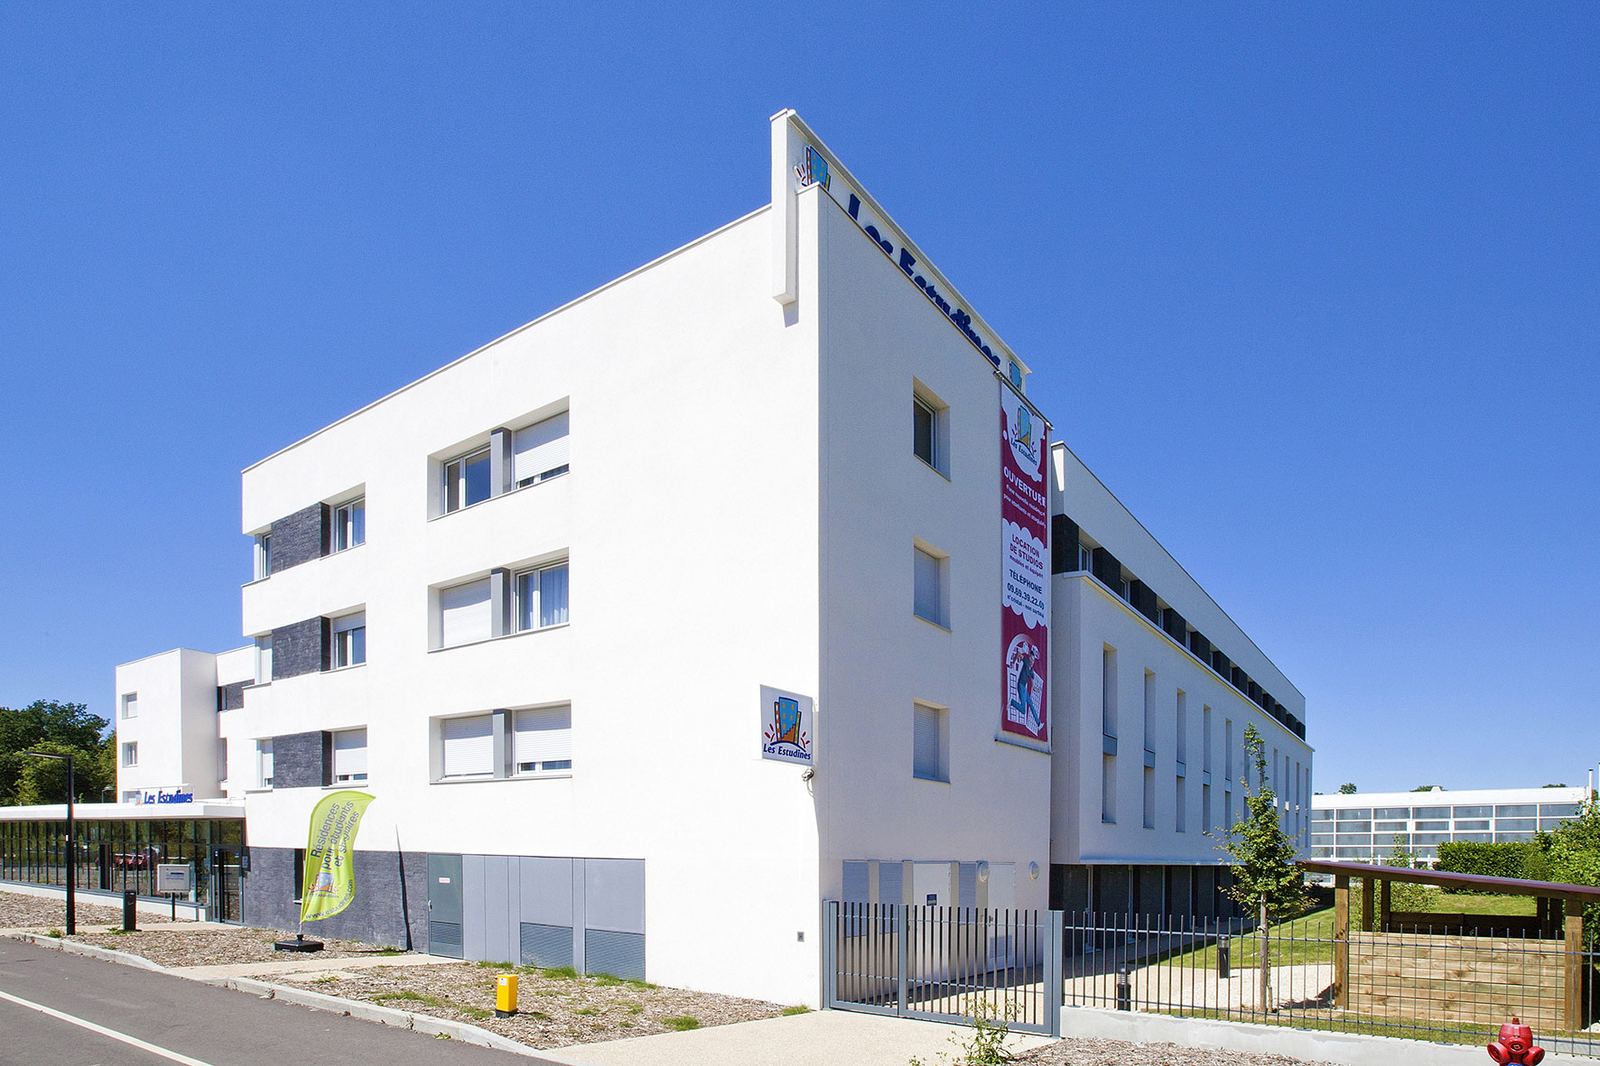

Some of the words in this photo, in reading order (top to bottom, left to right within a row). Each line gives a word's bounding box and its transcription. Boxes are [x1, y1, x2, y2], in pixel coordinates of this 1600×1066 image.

[1009, 542, 1018, 555] DE
[1018, 549, 1044, 570] STUDIOS
[1012, 533, 1041, 558] LOCATION
[1009, 568, 1042, 595] TÉLÉPHONE
[763, 743, 775, 754] Les
[778, 746, 811, 760] Estudines
[144, 791, 156, 804] Les
[157, 789, 193, 804] Estudines
[321, 847, 334, 870] pour
[334, 854, 344, 867] et
